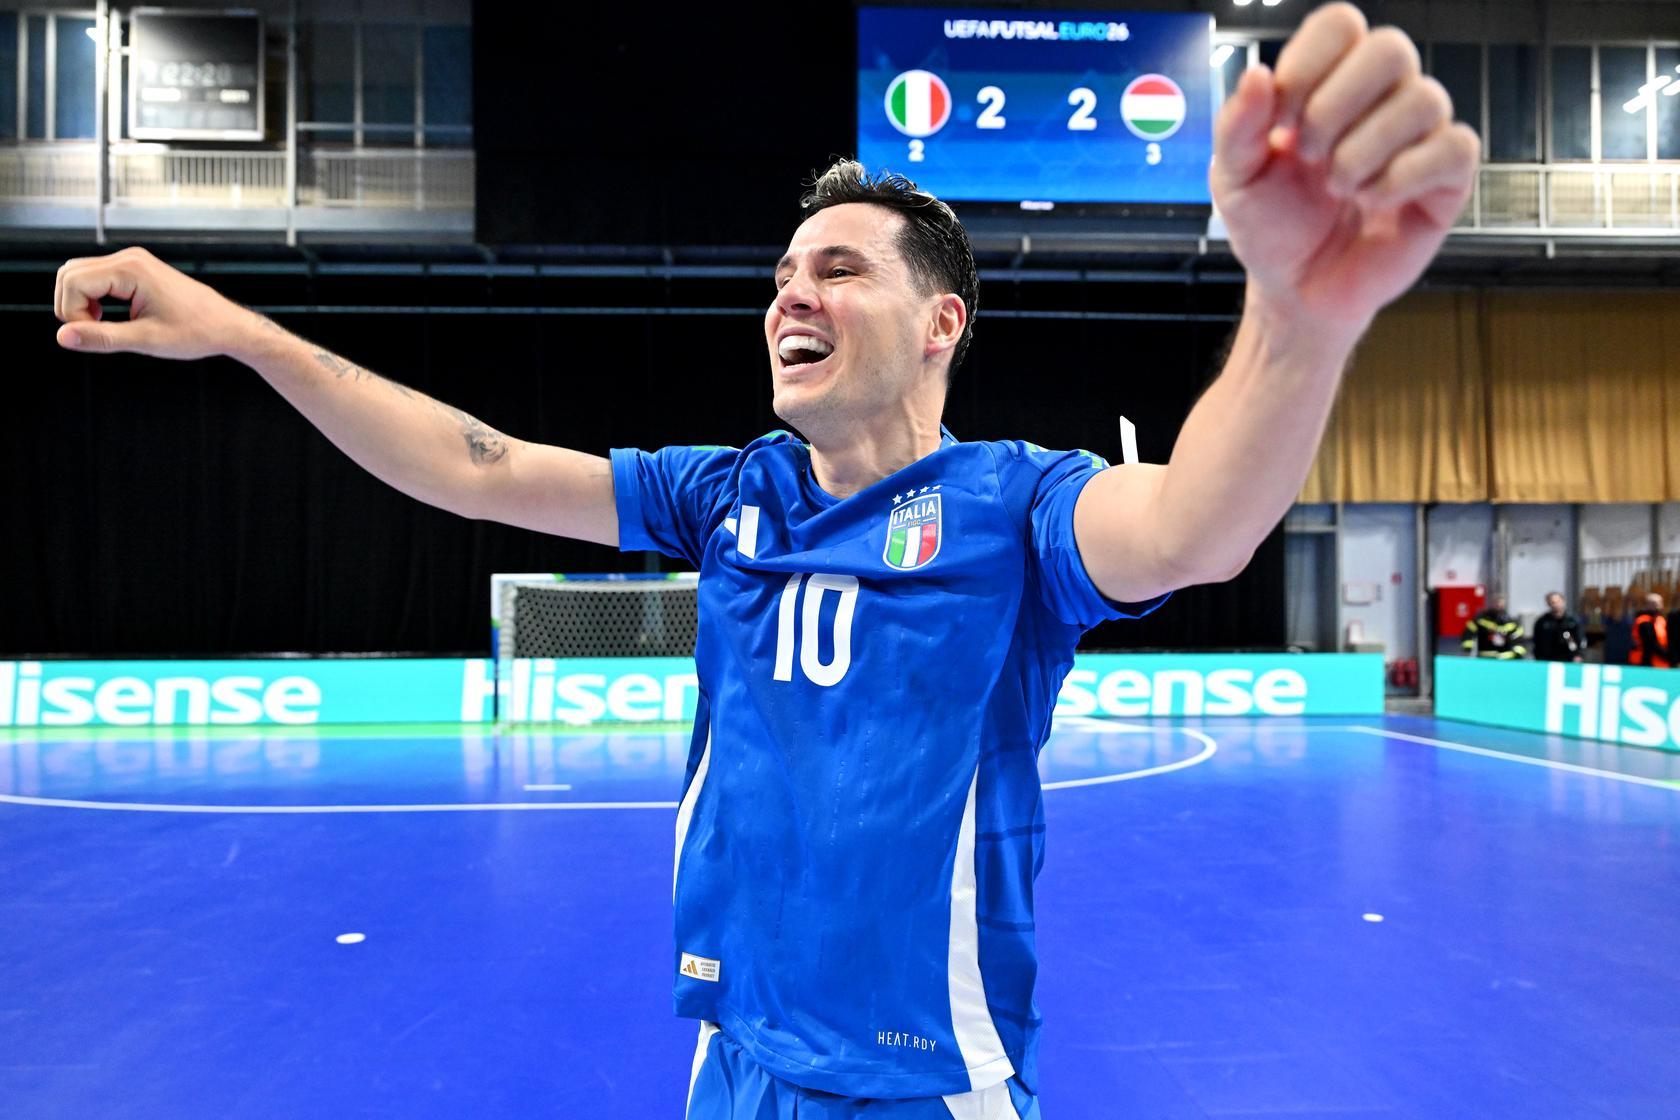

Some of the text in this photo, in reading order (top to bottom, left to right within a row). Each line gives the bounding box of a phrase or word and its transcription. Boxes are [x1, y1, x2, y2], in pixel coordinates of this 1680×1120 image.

[976, 86, 1097, 131] 2 2
[908, 139, 1162, 165] 2 3
[893, 500, 937, 525] ITALIA
[773, 572, 859, 687] 10
[0, 661, 321, 725] isense
[1545, 662, 1680, 750] His
[877, 1031, 937, 1052] HEAT.RDY
